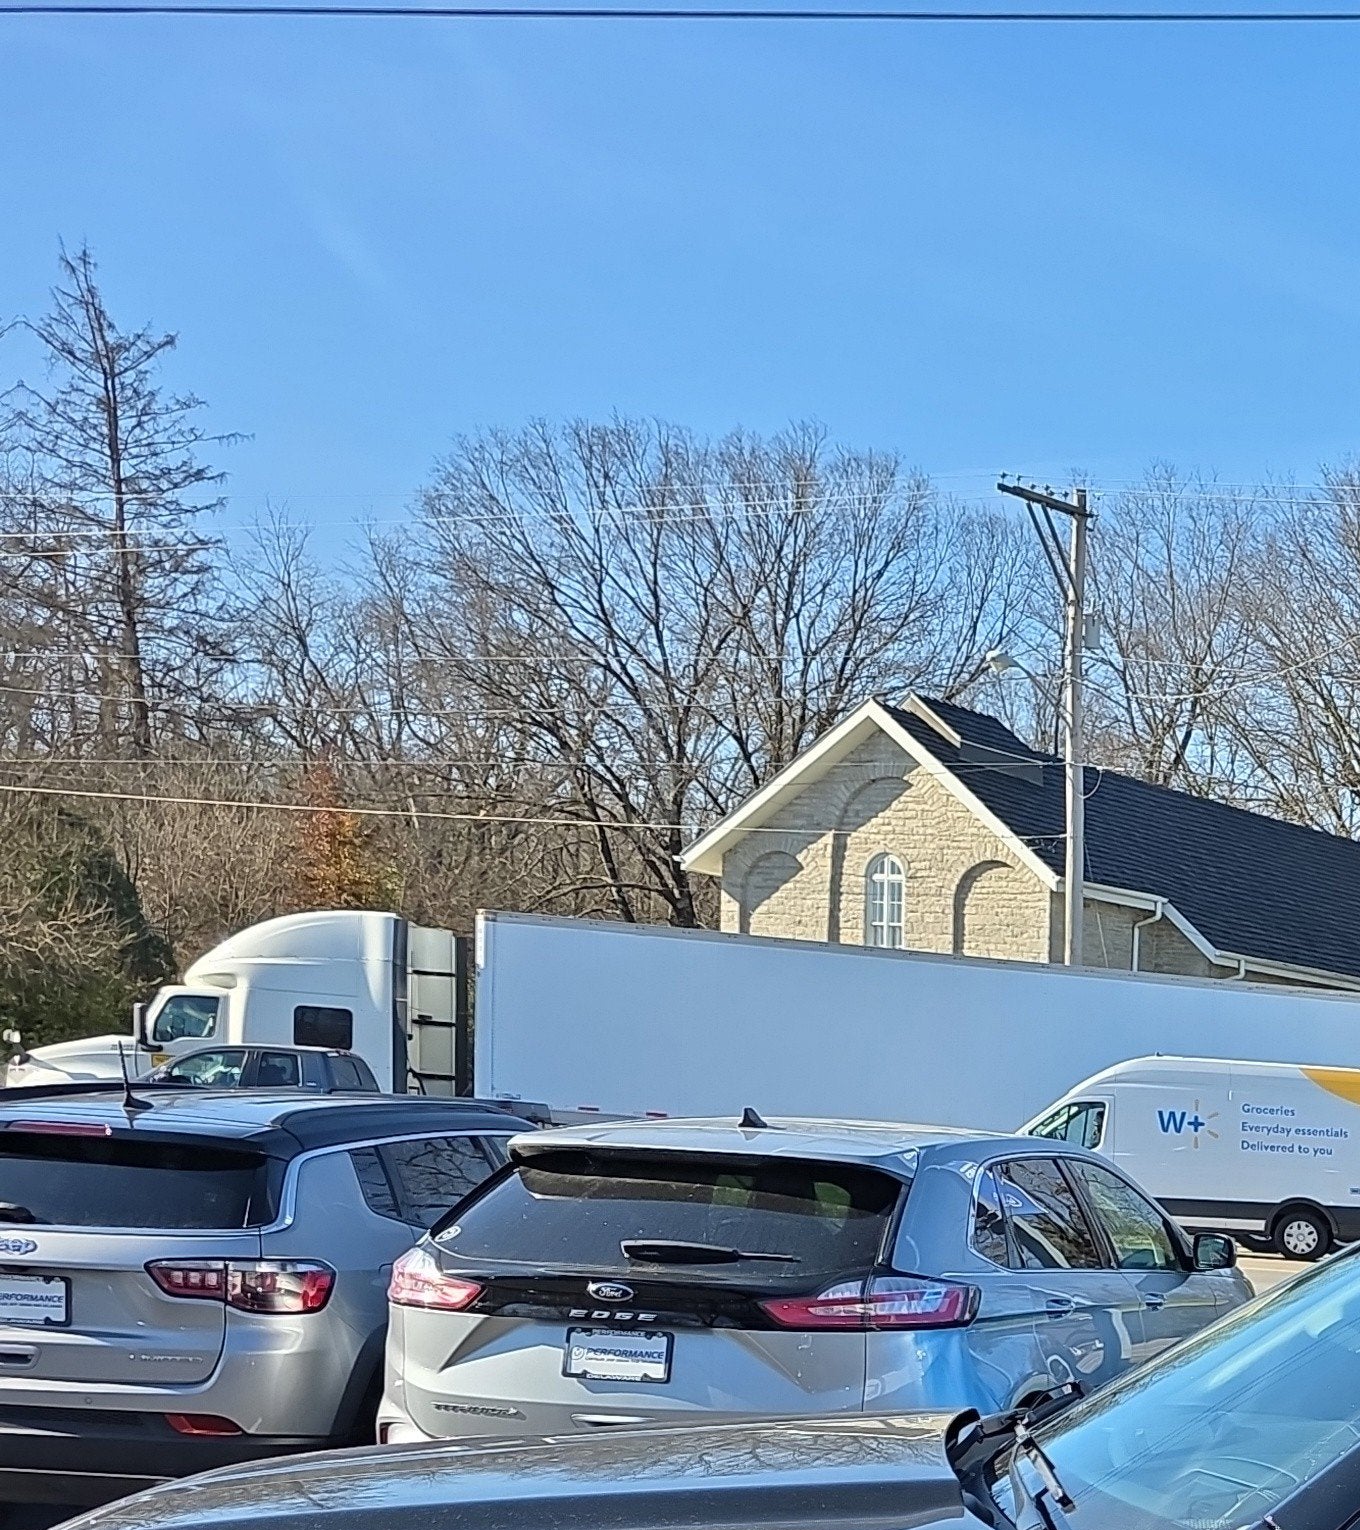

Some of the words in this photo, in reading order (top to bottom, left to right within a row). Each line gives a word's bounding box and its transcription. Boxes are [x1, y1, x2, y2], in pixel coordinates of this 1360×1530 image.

[1241, 1102, 1296, 1117] Groceries
[1241, 1121, 1292, 1138] Everyday
[1294, 1127, 1349, 1139] essentials
[1241, 1140, 1295, 1154] Delivered
[1298, 1144, 1310, 1155] to
[1312, 1147, 1333, 1158] you
[598, 1285, 623, 1298] Ford
[568, 1308, 658, 1322] EDGE
[586, 1347, 665, 1360] PERFORMANCE
